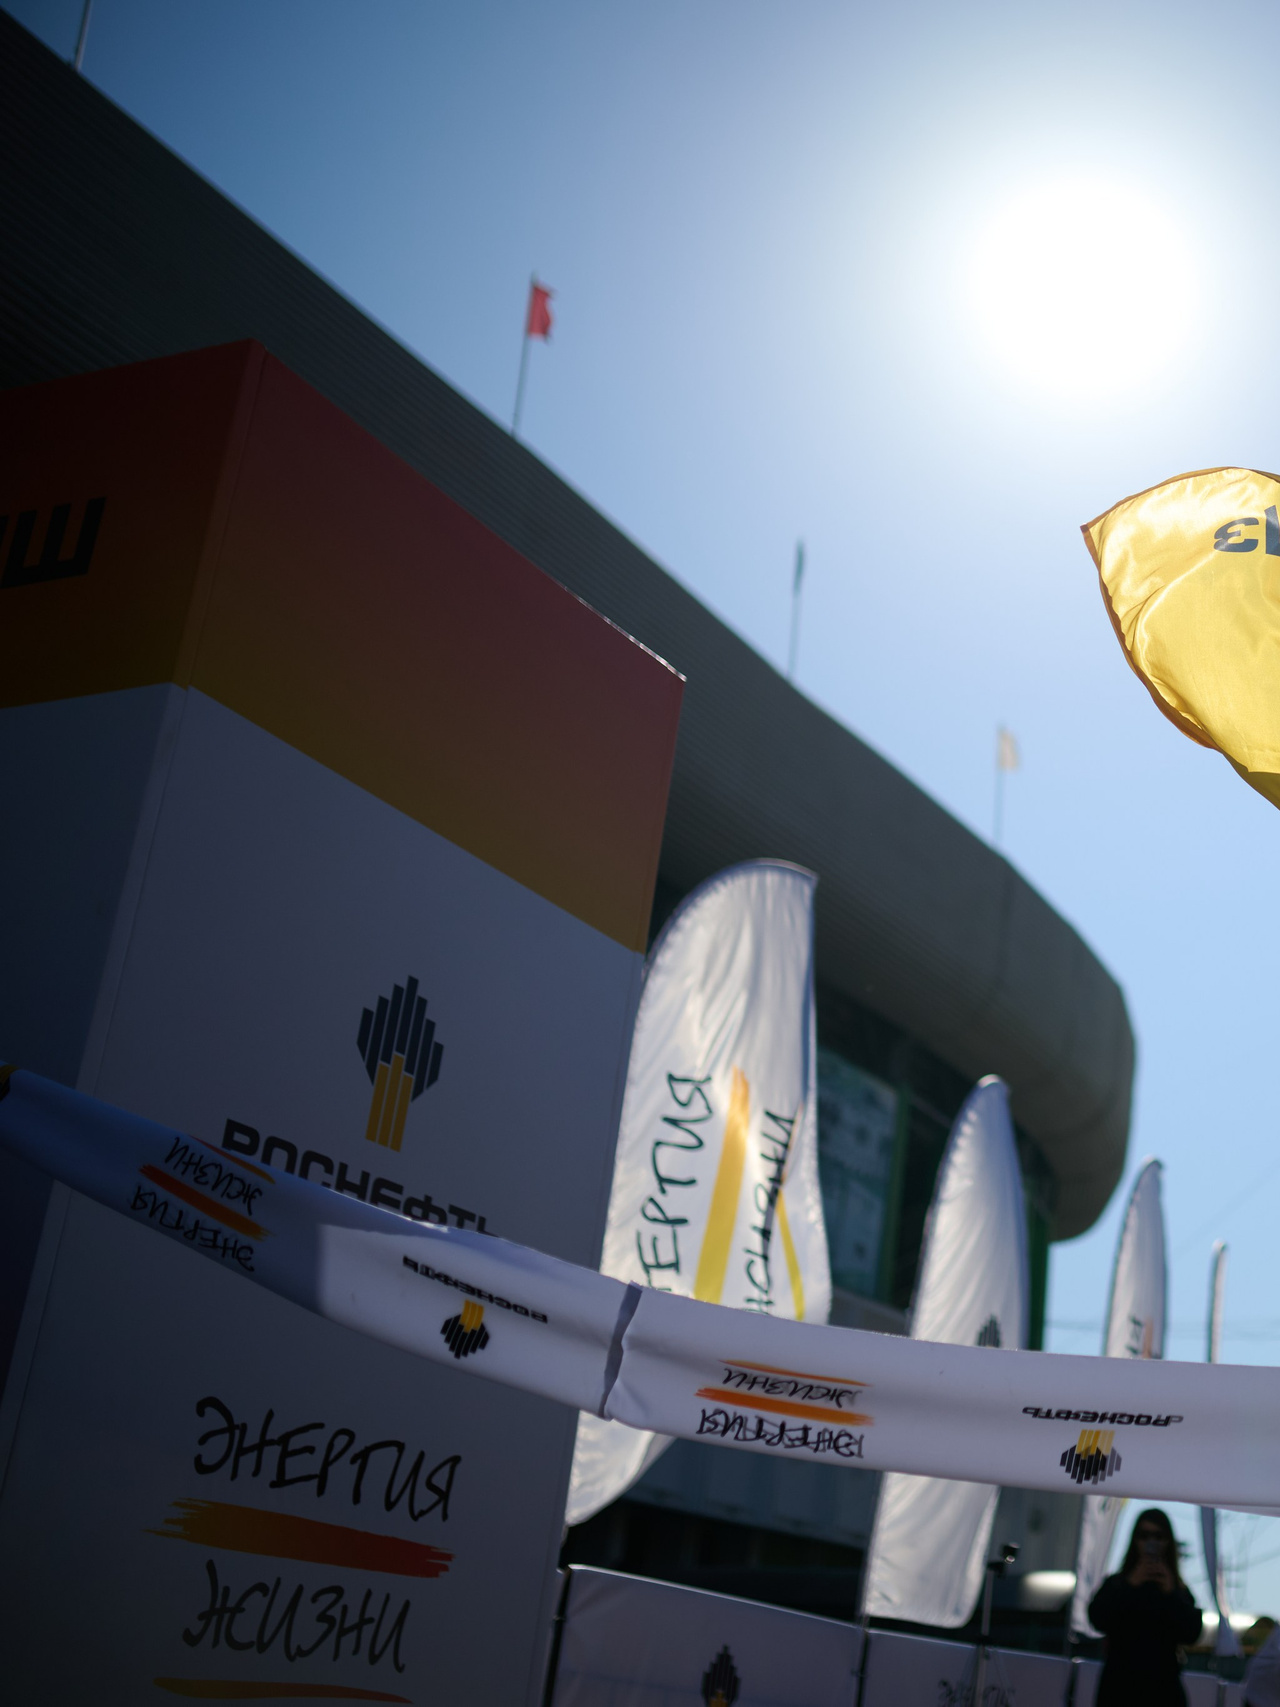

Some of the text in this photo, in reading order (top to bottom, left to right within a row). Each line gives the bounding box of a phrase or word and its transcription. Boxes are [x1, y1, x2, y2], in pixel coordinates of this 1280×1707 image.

[167, 1137, 262, 1214] ЖИЗНИ
[637, 1071, 712, 1293] ЕРГИЯ
[130, 1186, 254, 1272] ЭНЕРГИЯ
[403, 1256, 548, 1323] РОСНЕФТЬ
[194, 1396, 461, 1522] ЭНЕРГИЯ
[1022, 1407, 1184, 1427] РОСНЕФТЬ
[182, 1560, 412, 1672] ЖИЗНИ
